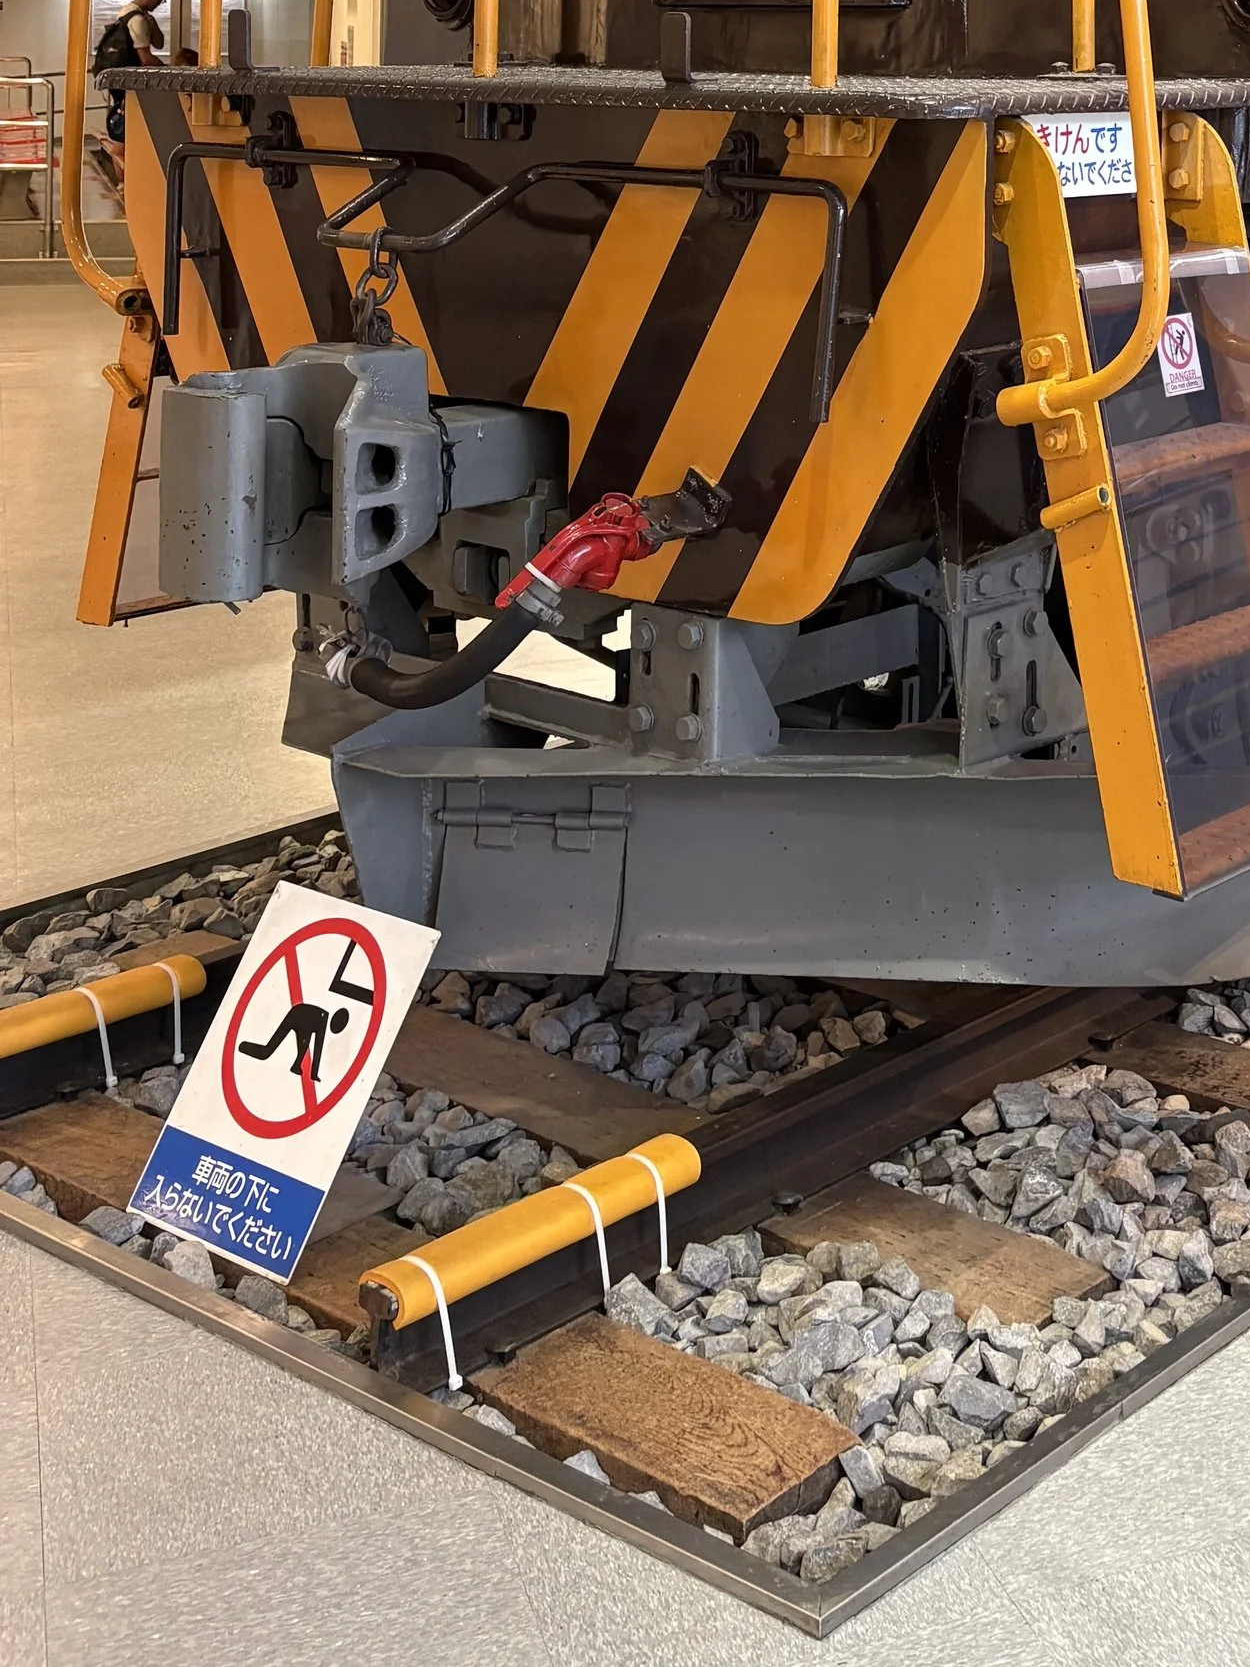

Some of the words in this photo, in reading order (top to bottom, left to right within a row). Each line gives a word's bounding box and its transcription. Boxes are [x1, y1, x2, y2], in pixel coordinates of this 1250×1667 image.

[1169, 369, 1197, 384] DANGER
[191, 1155, 280, 1214] 車両の下に
[144, 1174, 293, 1261] 入らないでください
